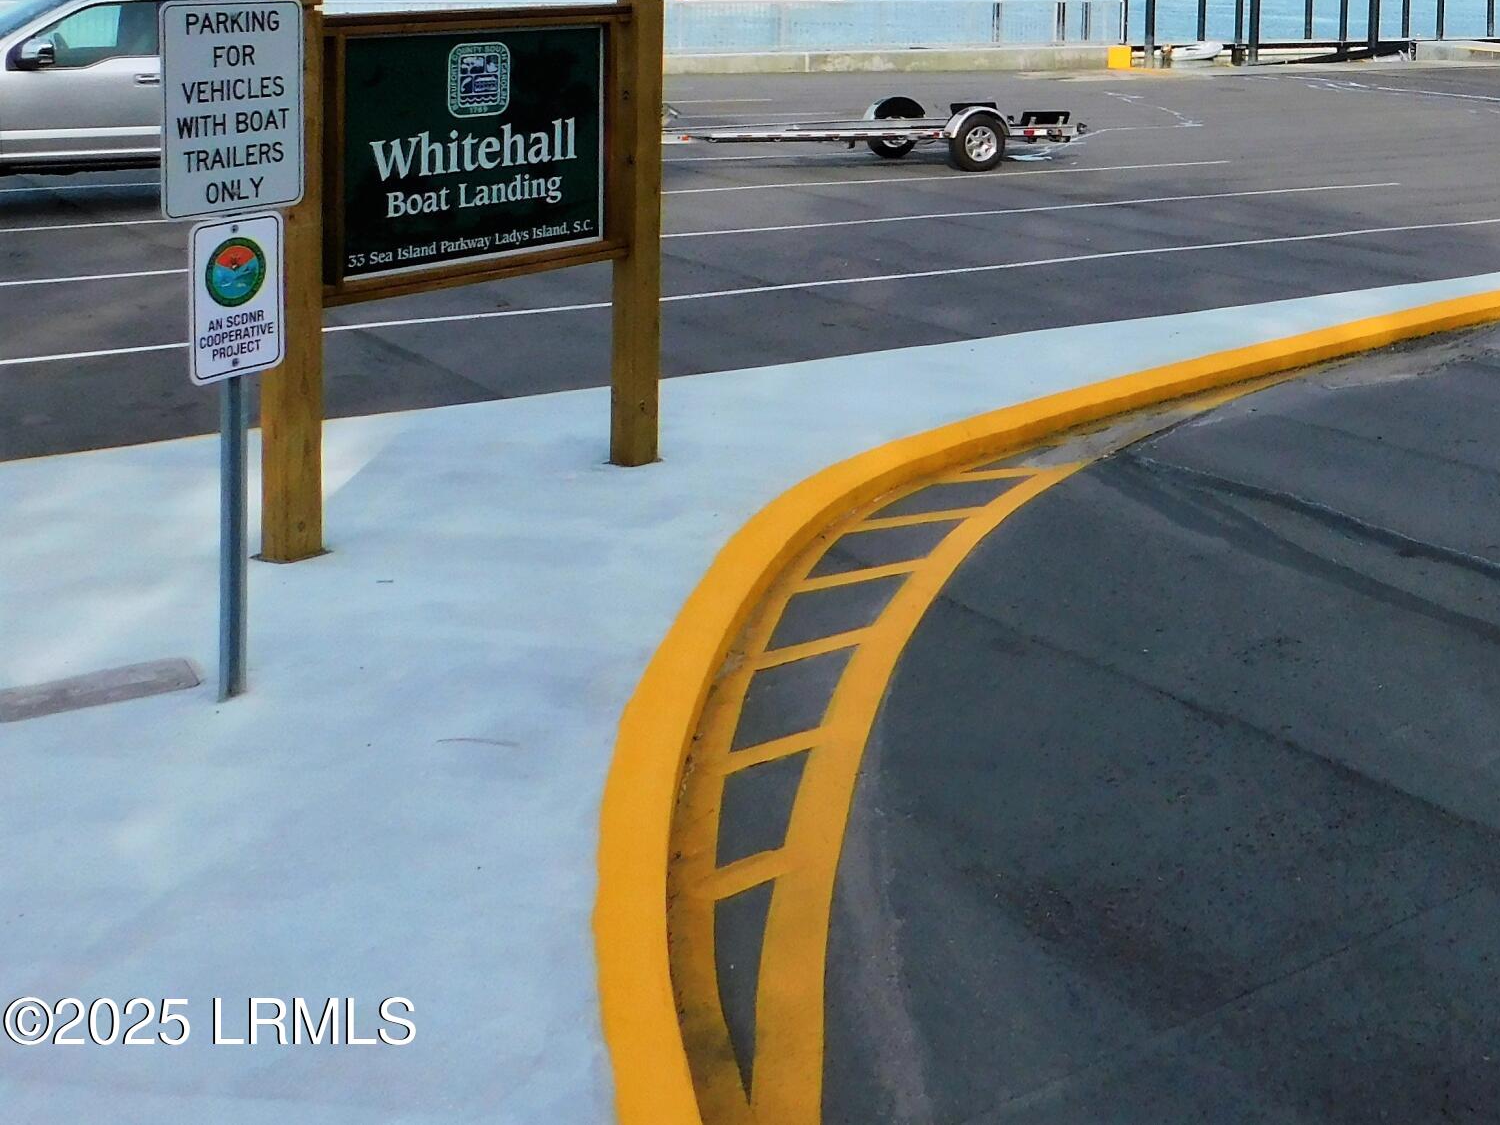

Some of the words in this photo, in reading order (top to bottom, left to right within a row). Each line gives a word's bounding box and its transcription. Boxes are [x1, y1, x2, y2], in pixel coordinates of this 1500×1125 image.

[185, 10, 280, 35] PARKING
[213, 44, 255, 68] FOR
[181, 76, 285, 105] VEHICLES
[176, 113, 227, 140] WITH
[235, 107, 290, 134] BOAT
[183, 141, 284, 173] TRAILERS
[369, 117, 578, 182] Whitehall
[206, 176, 264, 204] ONLY
[385, 187, 451, 219] Boat
[458, 173, 563, 208] Landing
[347, 254, 366, 268] 33
[369, 251, 393, 265] Sea
[397, 241, 437, 260] Island
[440, 235, 491, 254] Parkway
[495, 229, 529, 245] Ladys
[532, 221, 570, 239] Island,
[573, 219, 594, 233] S.C.
[199, 321, 274, 349] COOPERATIVE
[208, 318, 223, 333] AN
[226, 309, 265, 328] SCDNR
[212, 339, 261, 362] PROJECT
